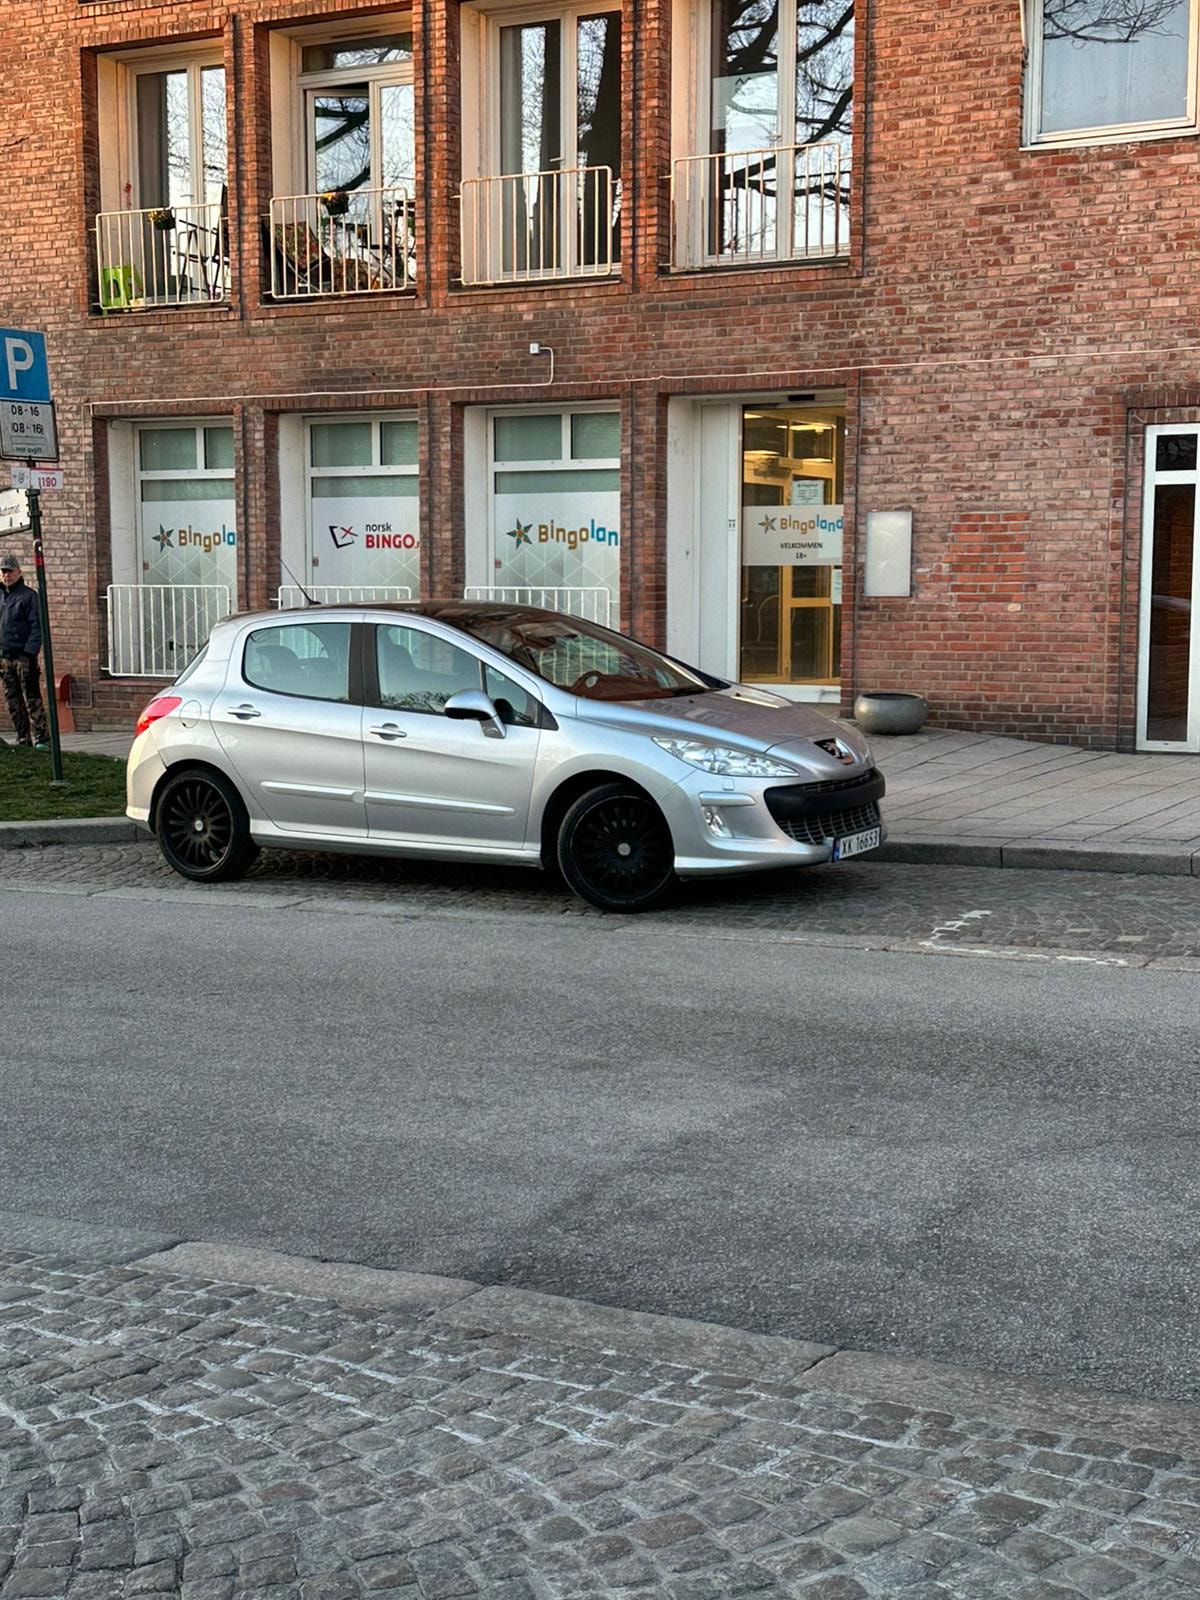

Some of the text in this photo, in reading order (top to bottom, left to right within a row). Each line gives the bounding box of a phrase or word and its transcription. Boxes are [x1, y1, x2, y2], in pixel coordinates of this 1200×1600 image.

[5, 336, 35, 390] P
[365, 522, 392, 532] norsk
[538, 518, 619, 550] Bingolan
[780, 513, 844, 535] Bingoland
[178, 524, 236, 552] Bingola
[841, 829, 879, 855] XK 16653
